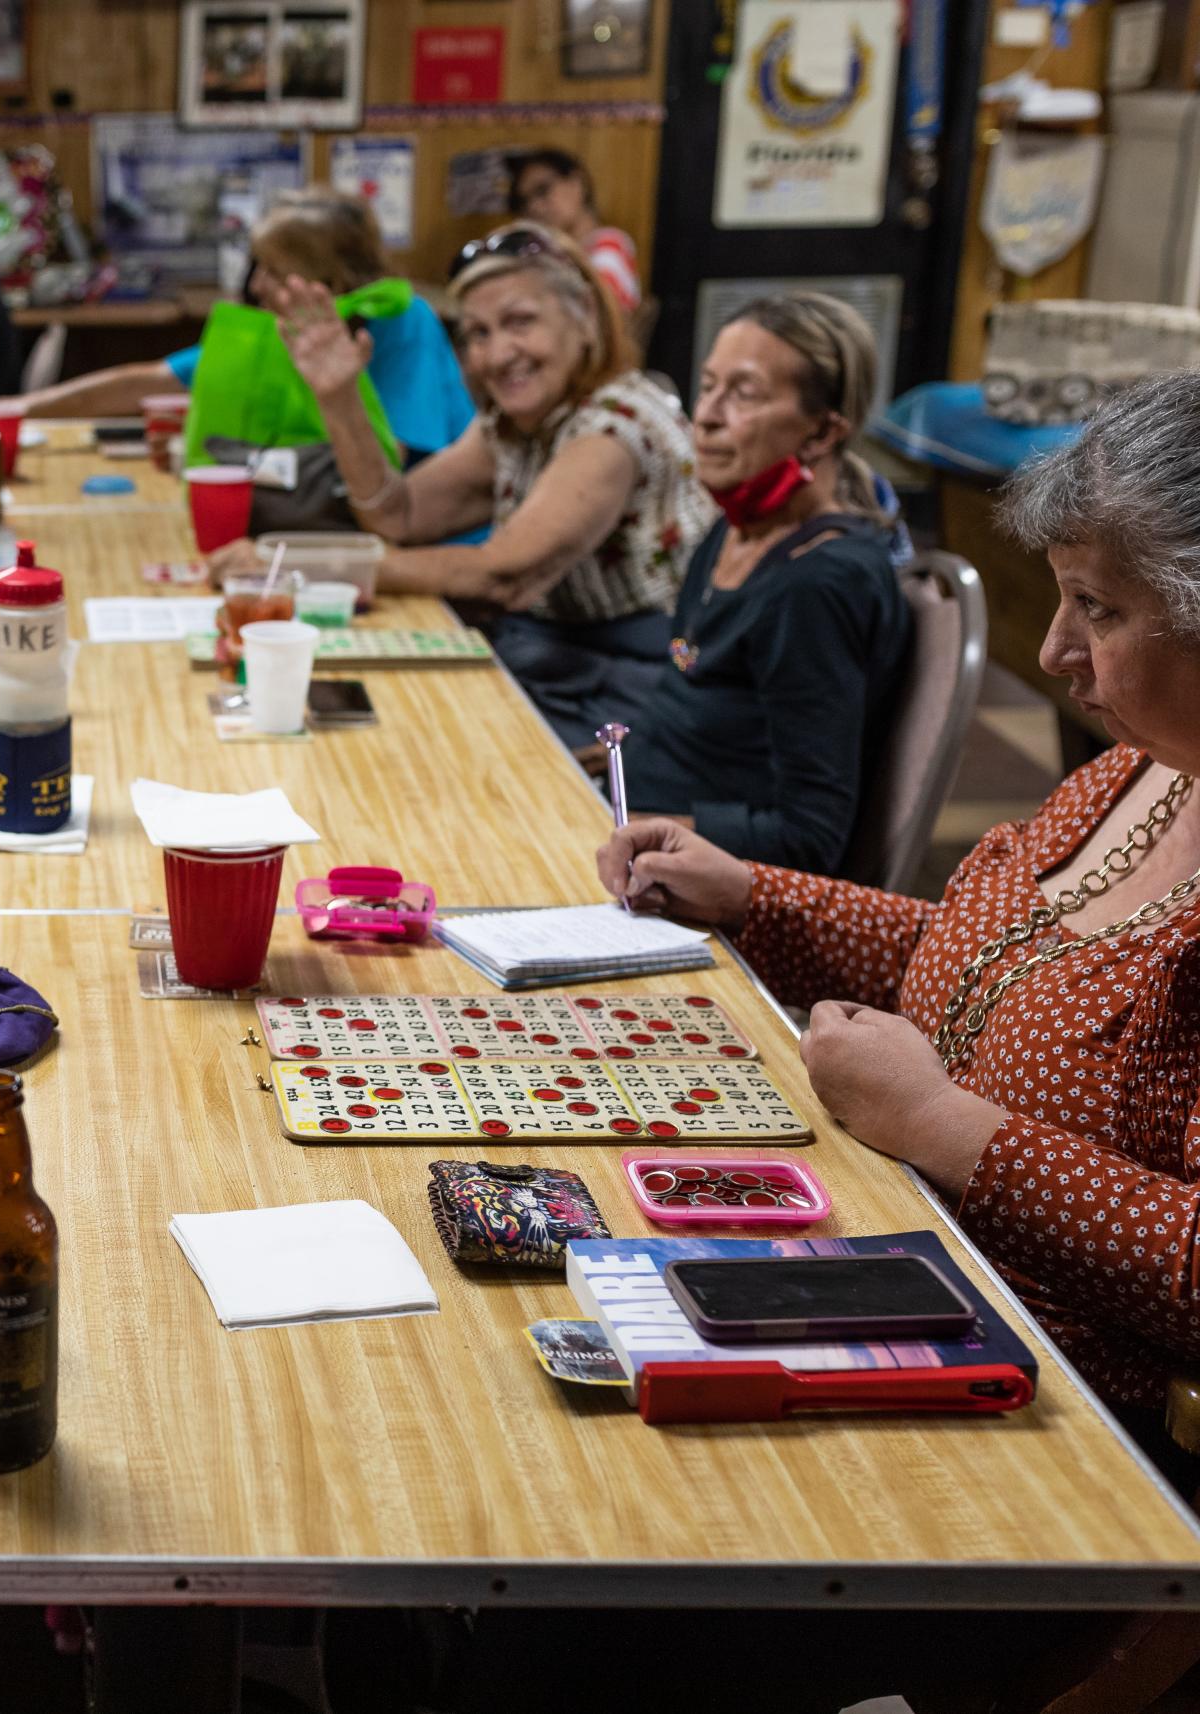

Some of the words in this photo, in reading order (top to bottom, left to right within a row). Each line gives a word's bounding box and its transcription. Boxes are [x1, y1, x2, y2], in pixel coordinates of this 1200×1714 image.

[299, 1034, 319, 1042] 21
[328, 1033, 347, 1041] 19
[385, 1033, 405, 1042] 29
[414, 1034, 435, 1042] 20
[449, 1035, 470, 1043] 27
[332, 1047, 352, 1055] 15
[390, 1046, 410, 1054] 10
[365, 1065, 386, 1074] 63
[395, 1065, 416, 1073] 74
[460, 1065, 482, 1074] 64
[490, 1065, 512, 1074] 69
[550, 1065, 572, 1074] 63
[617, 1065, 640, 1073] 63
[646, 1065, 669, 1073] 67
[677, 1065, 699, 1073] 71
[706, 1065, 730, 1073] 75
[309, 1078, 331, 1086] 52
[370, 1078, 391, 1086] 47
[400, 1078, 423, 1086] 54
[431, 1078, 452, 1087] 60
[467, 1078, 488, 1087] 49
[497, 1079, 520, 1087] 57
[528, 1079, 550, 1087] 51
[588, 1078, 611, 1087] 56
[625, 1078, 648, 1087] 52
[656, 1078, 678, 1087] 51
[685, 1078, 709, 1086] 54
[715, 1078, 739, 1087] 49
[746, 1078, 772, 1087] 57
[314, 1091, 334, 1100] 44
[344, 1091, 365, 1100] 42
[406, 1091, 428, 1099] 37
[436, 1091, 457, 1100] 40
[473, 1091, 496, 1100] 38
[504, 1091, 526, 1100] 45
[566, 1092, 588, 1101] 41
[597, 1092, 620, 1101] 33
[634, 1091, 658, 1100] 35
[664, 1091, 686, 1100] 42
[726, 1091, 749, 1100] 40
[757, 1091, 782, 1101] 38
[317, 1105, 340, 1115] 24
[380, 1105, 403, 1115] 25
[412, 1104, 435, 1115] 22
[443, 1105, 466, 1115] 23
[480, 1105, 504, 1115] 20
[511, 1105, 535, 1115] 22
[542, 1105, 566, 1114] 17
[642, 1105, 666, 1114] 19
[705, 1105, 728, 1114] 16
[736, 1104, 761, 1115] 22
[768, 1106, 793, 1116] 21
[385, 1120, 408, 1130] 12
[448, 1120, 471, 1130] 14
[550, 1121, 573, 1131] 15
[683, 1120, 707, 1130] 15
[715, 1121, 739, 1130] 11
[574, 1254, 706, 1350] DARE
[542, 1350, 616, 1361] VIKINGS
